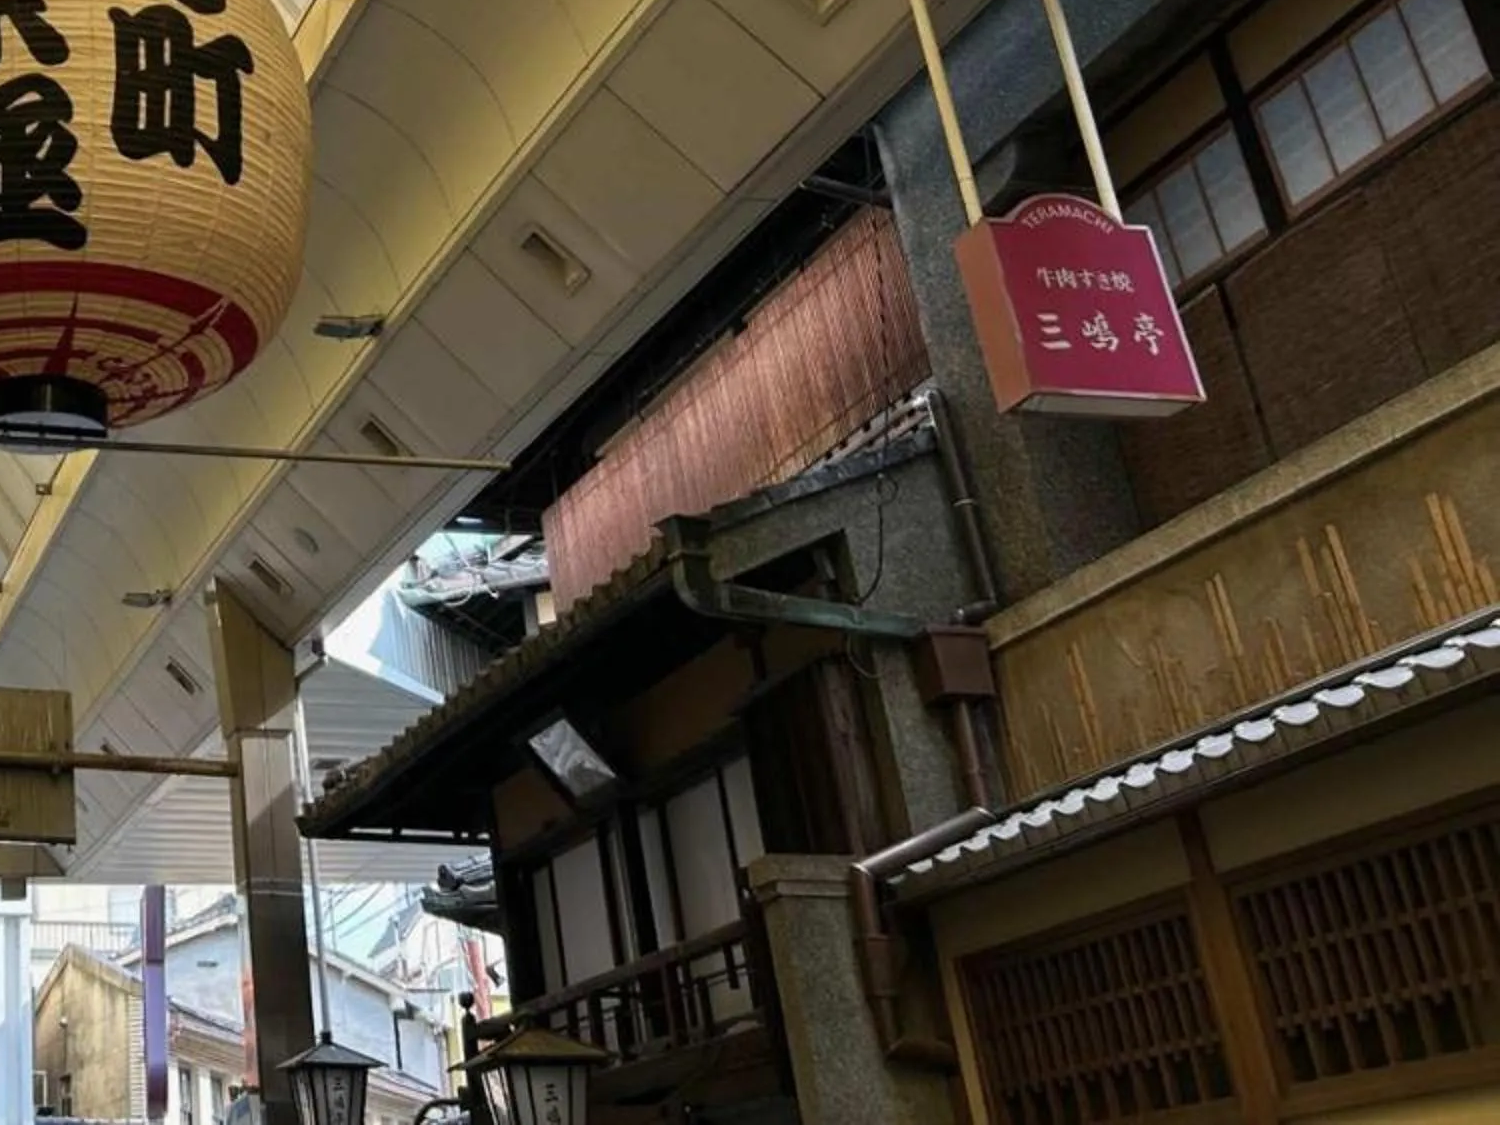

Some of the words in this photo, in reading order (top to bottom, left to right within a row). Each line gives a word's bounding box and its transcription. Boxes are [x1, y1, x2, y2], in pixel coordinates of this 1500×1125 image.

[1020, 204, 1115, 235] TERAMACHI
[1037, 311, 1165, 357] 三嶋亭
